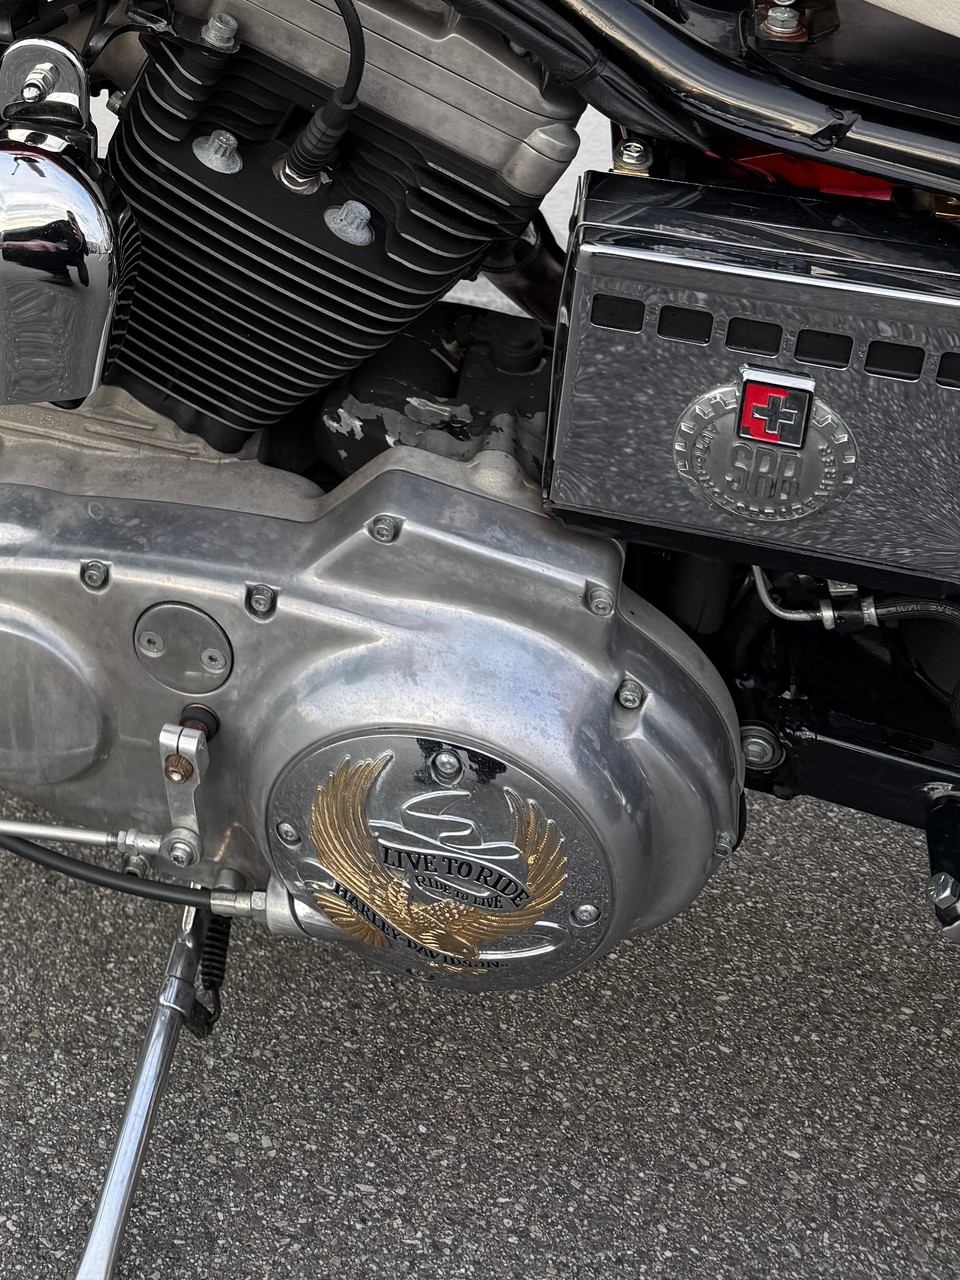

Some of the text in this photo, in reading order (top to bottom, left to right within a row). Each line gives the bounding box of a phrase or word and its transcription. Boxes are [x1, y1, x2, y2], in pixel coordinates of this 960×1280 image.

[381, 845, 531, 909] LIVE TO RIDE
[414, 875, 503, 910] RIDE TO LIVE
